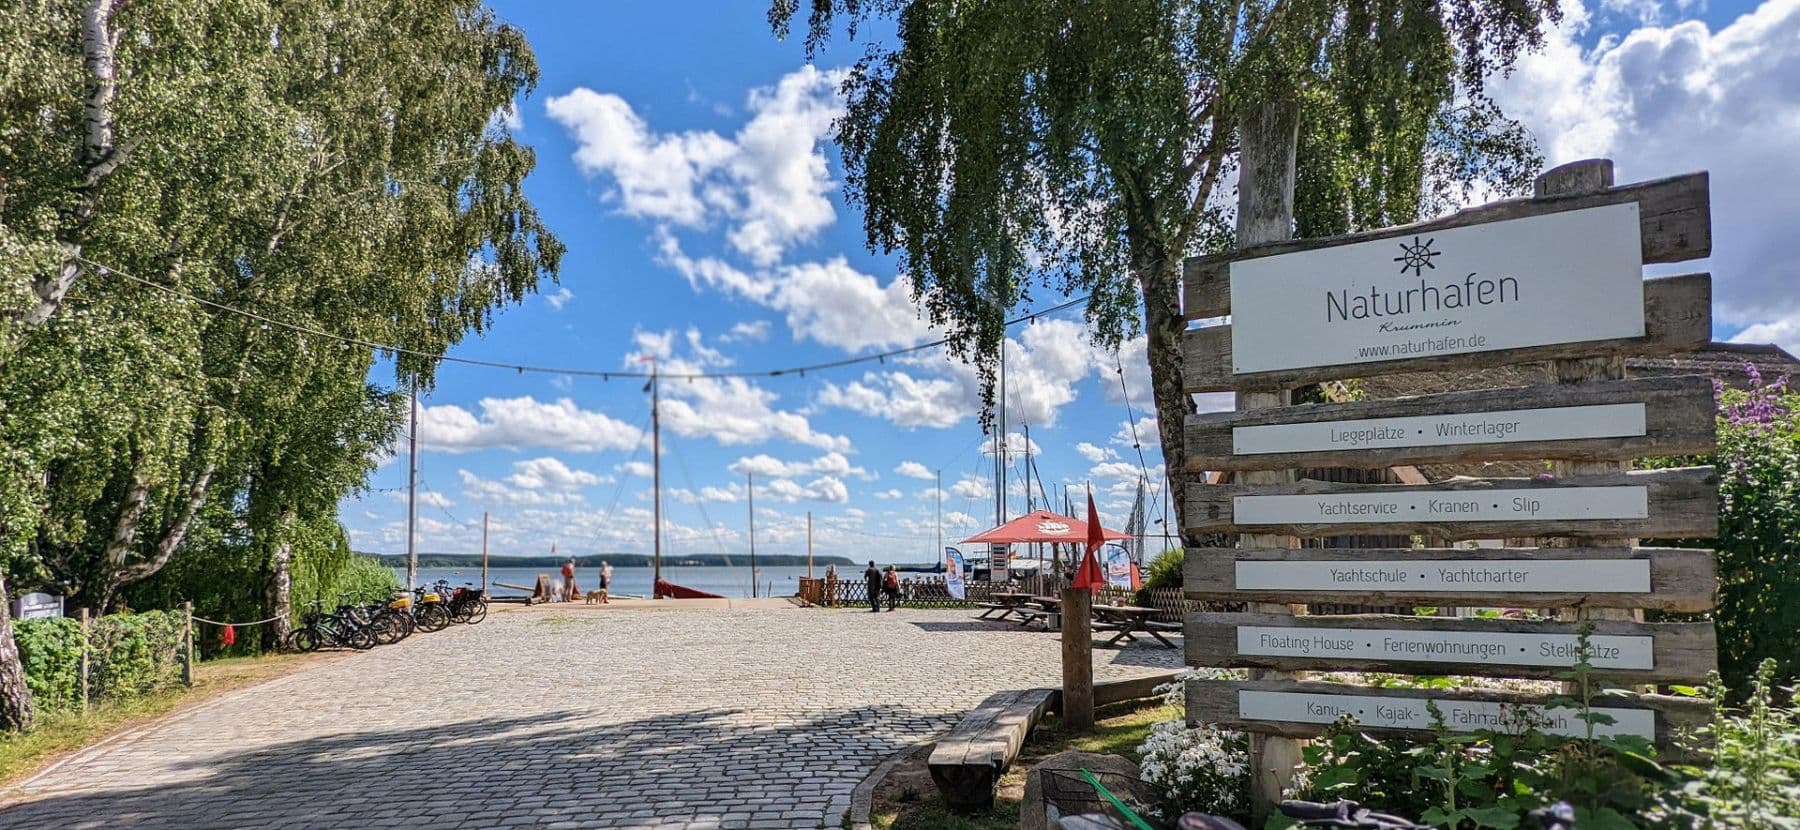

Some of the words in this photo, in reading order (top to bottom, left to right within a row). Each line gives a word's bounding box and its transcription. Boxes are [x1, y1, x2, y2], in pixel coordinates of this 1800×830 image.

[1326, 272, 1519, 322] Naturhafen
[1378, 318, 1462, 333] Krummin
[1358, 333, 1486, 358] www.naturhafen.de
[1330, 426, 1405, 446] Liegeplätze
[1435, 420, 1520, 441] Winterlager
[1317, 501, 1398, 516] Yachtservice
[1428, 499, 1479, 514] Kranen
[1512, 498, 1541, 516] Slip
[1329, 568, 1408, 583] Yachtschule
[1438, 568, 1529, 583] Yachtcharter
[1260, 634, 1310, 653] Floating
[1313, 636, 1354, 650] House
[1383, 637, 1506, 660] Ferienwohnungen
[1539, 641, 1620, 663] Stellpätze
[1307, 701, 1346, 717] Kanu-
[1376, 705, 1420, 724] Kajak-
